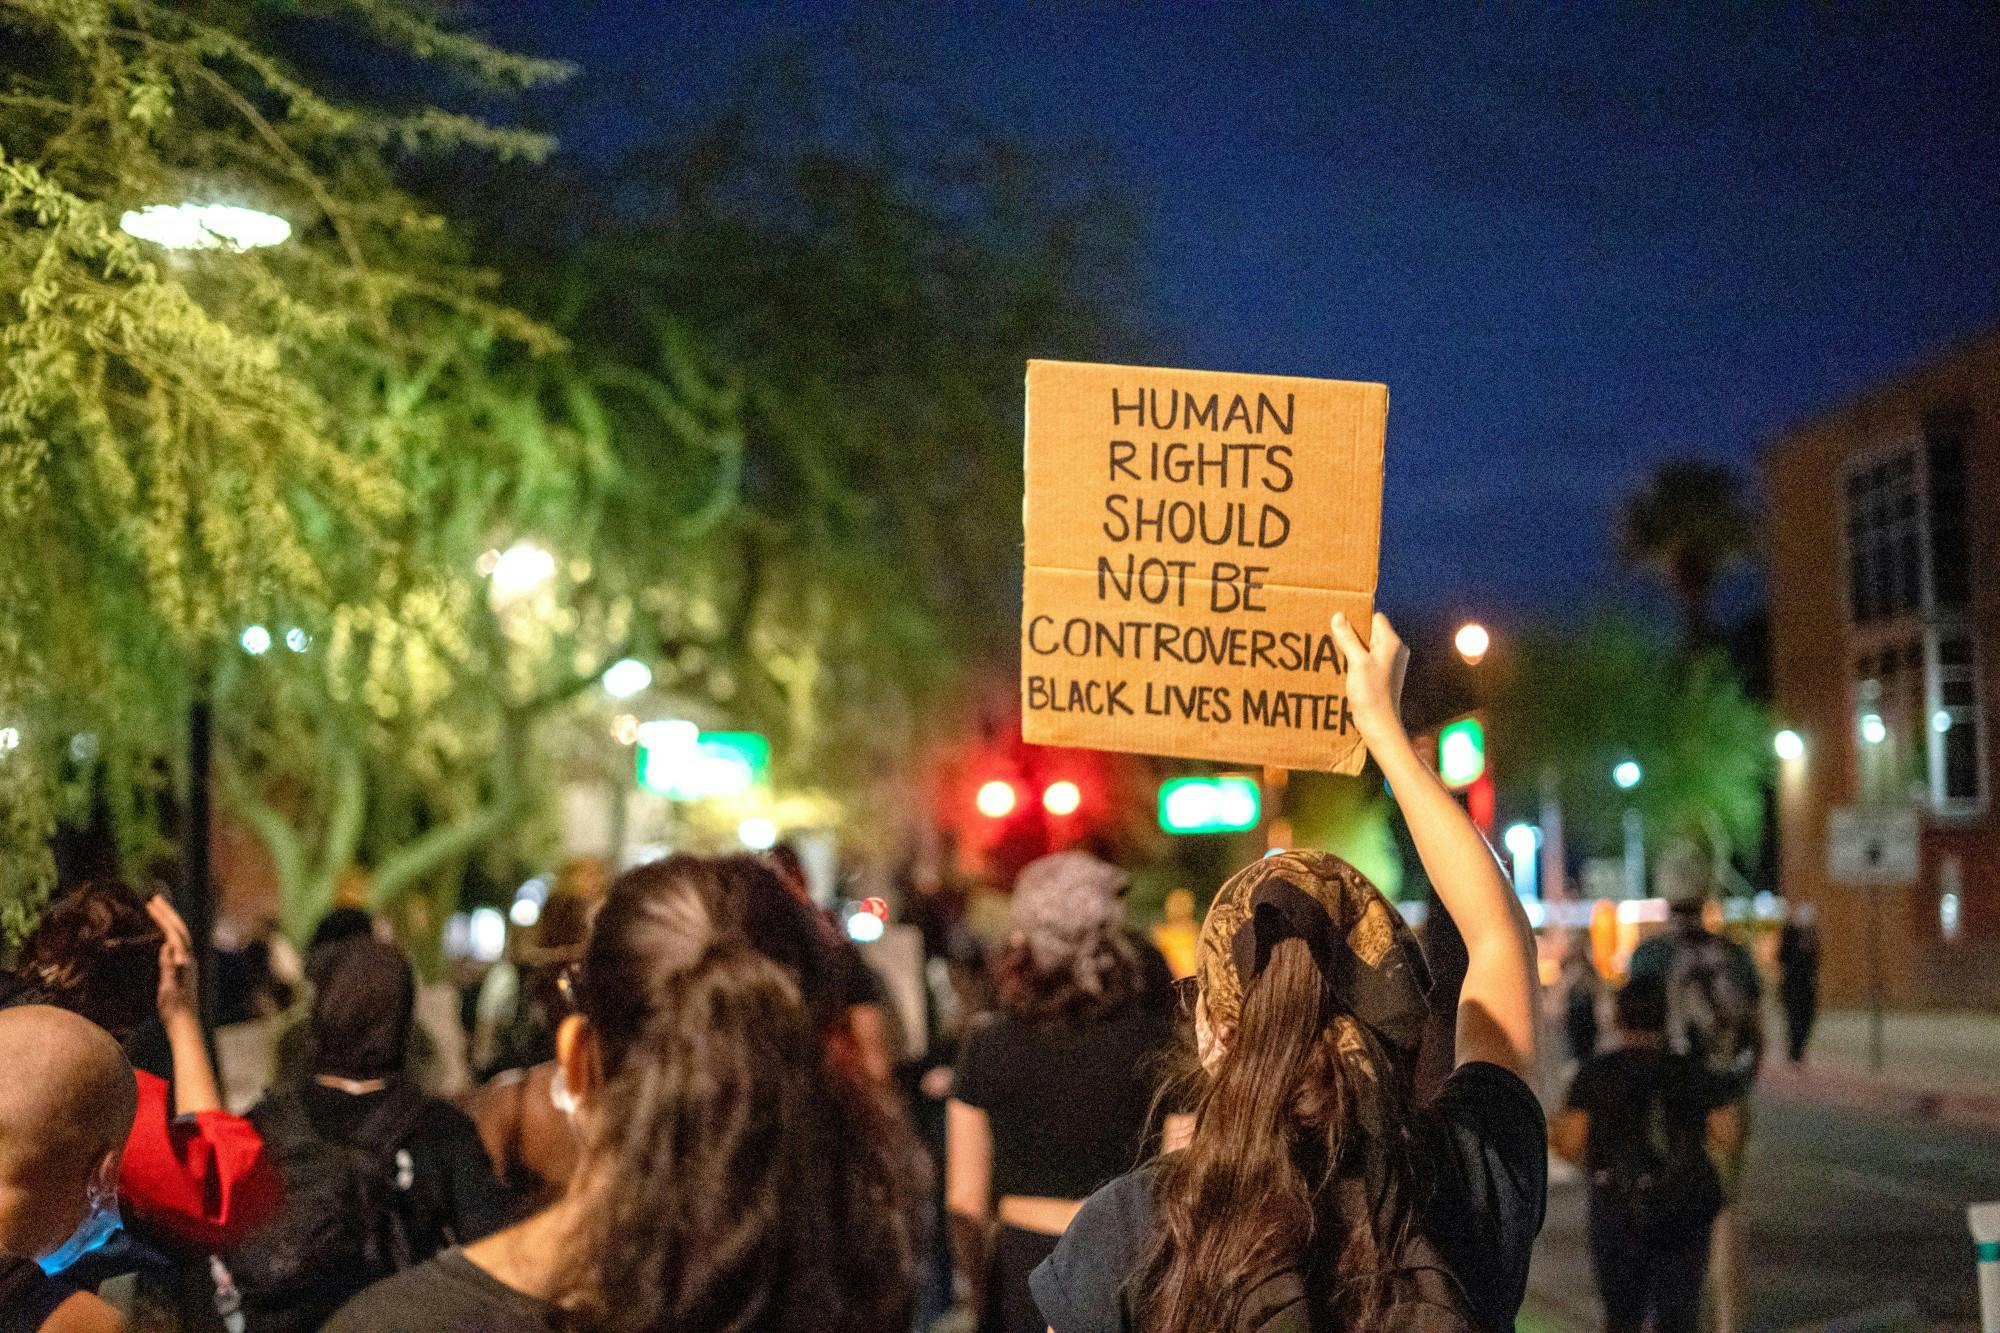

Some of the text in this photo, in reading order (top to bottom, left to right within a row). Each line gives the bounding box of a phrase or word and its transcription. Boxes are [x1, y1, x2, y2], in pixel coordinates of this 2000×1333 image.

[1112, 388, 1295, 435] HUMAN
[1109, 441, 1293, 493] RIGHTS
[1103, 494, 1290, 548] SHOULD
[1098, 553, 1269, 613] NOT BE
[1028, 615, 1348, 673] CONTROVERSIA
[1027, 675, 1134, 717] BLACK
[1146, 682, 1231, 723] LIVES
